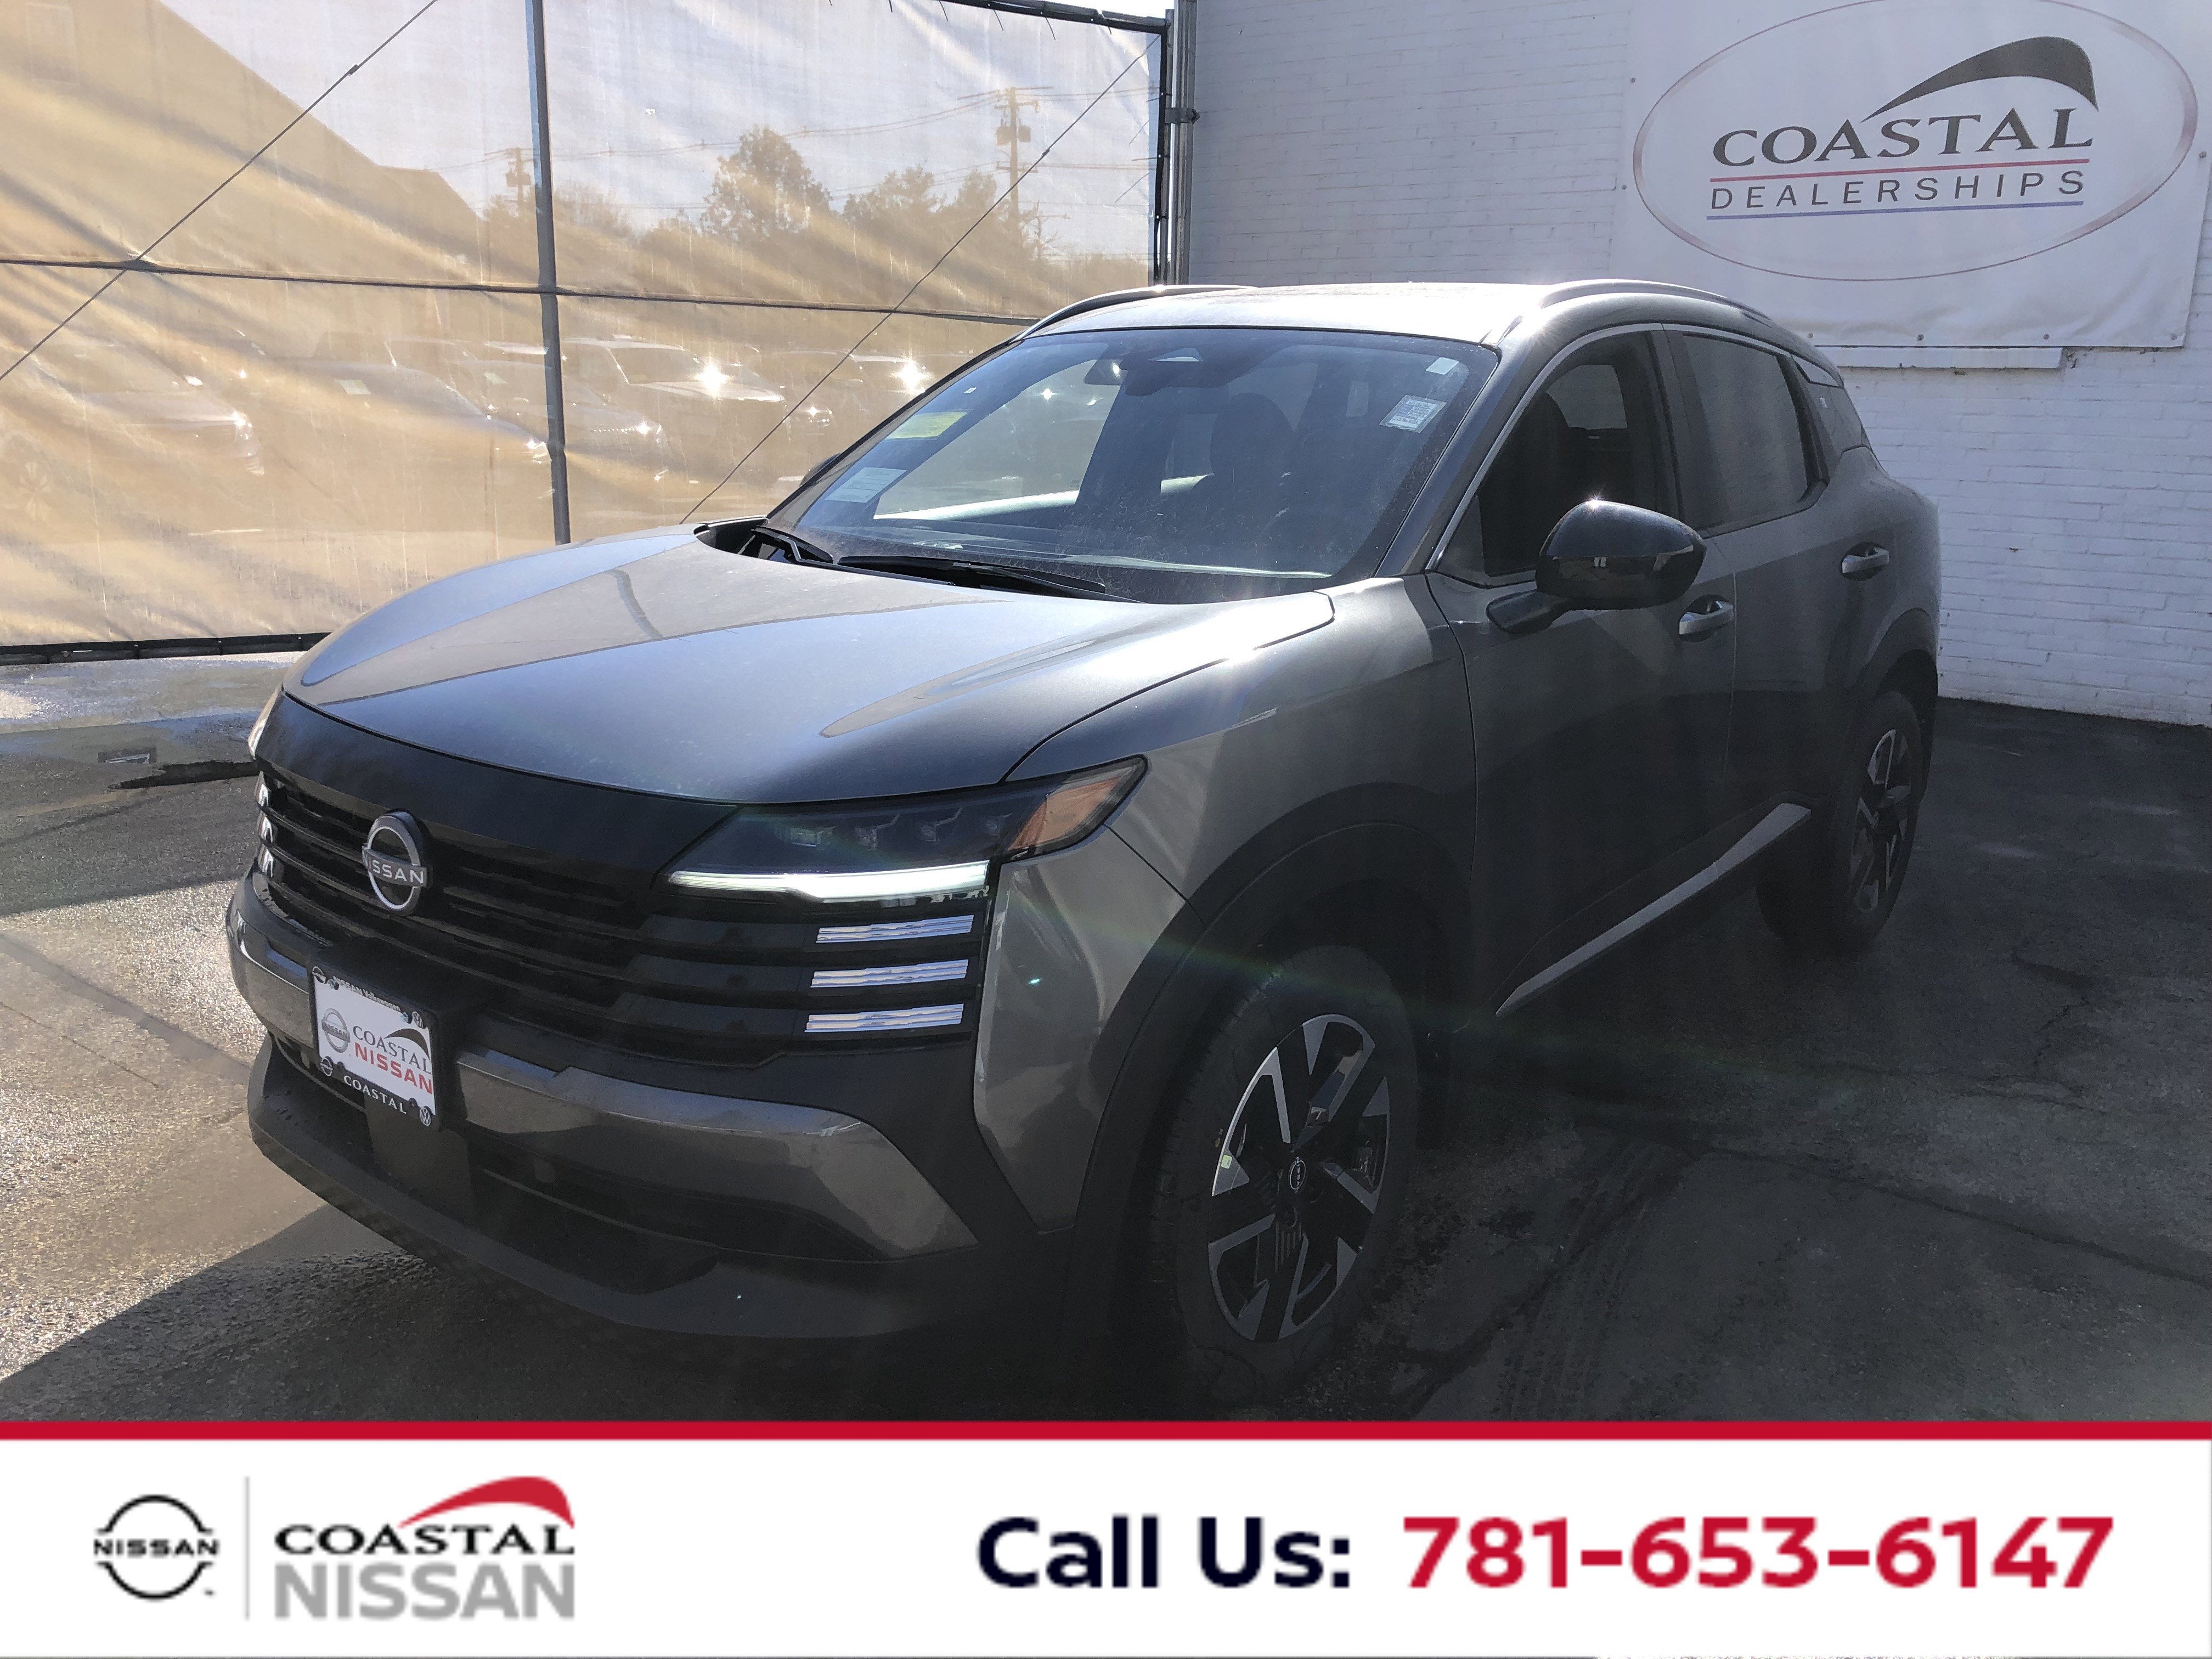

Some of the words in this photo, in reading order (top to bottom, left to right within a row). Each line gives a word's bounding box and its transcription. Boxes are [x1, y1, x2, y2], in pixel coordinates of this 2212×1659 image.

[1713, 108, 2093, 167] COASTAL
[1711, 170, 2084, 210] DEALERSHIPS
[353, 1025, 432, 1074] COASTAL
[354, 1042, 432, 1094] NISSAN
[343, 1075, 407, 1114] COASTAL
